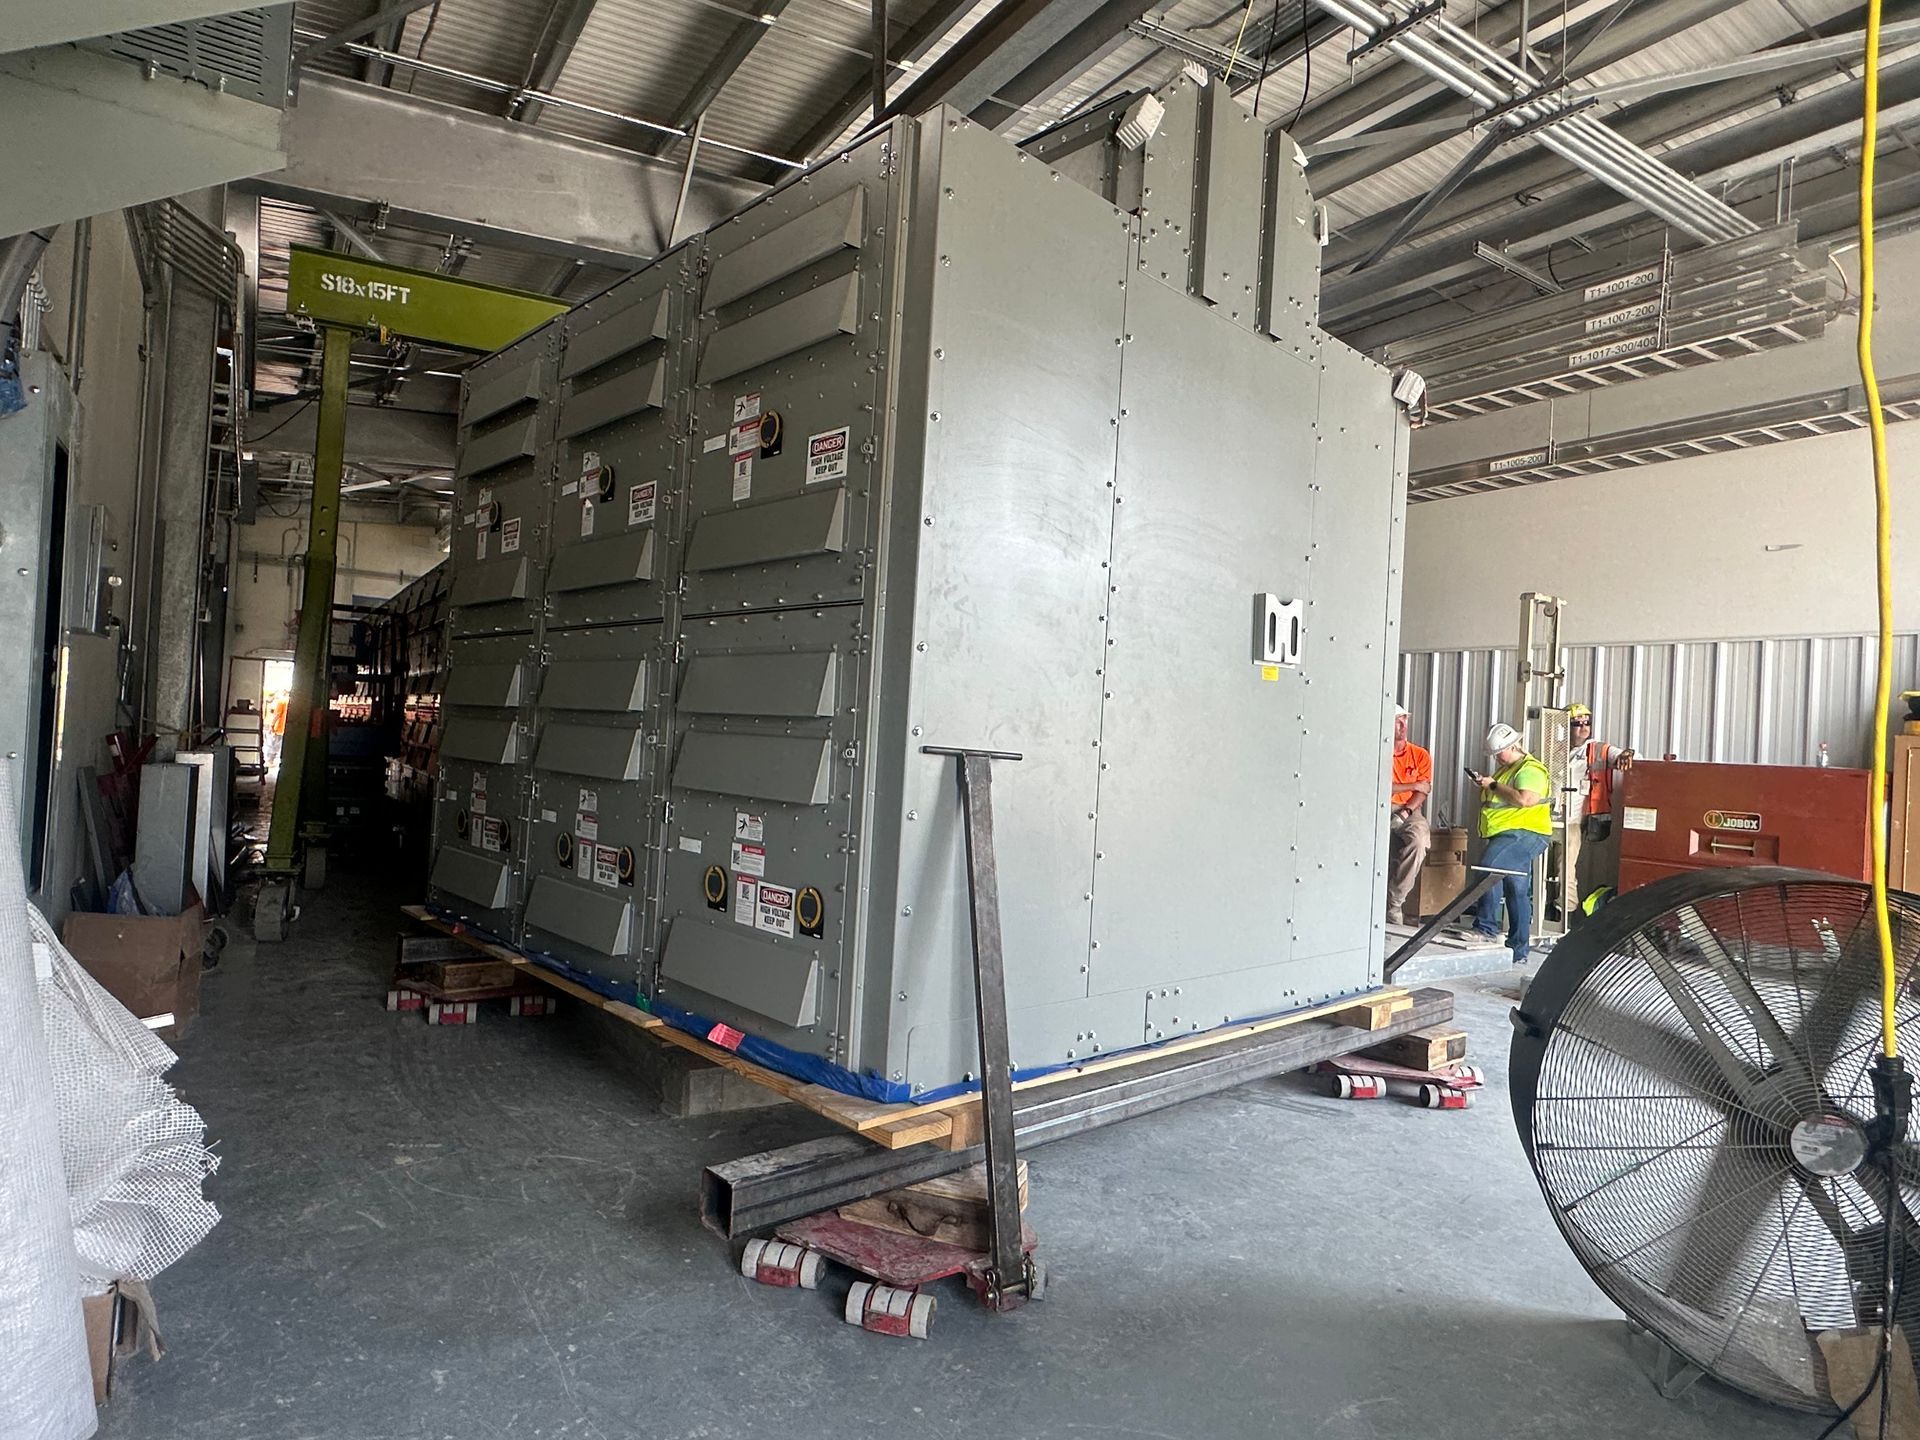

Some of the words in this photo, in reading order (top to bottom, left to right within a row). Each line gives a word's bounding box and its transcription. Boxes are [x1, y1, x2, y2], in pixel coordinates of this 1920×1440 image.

[321, 273, 410, 304] S18x15FT
[1590, 272, 1654, 298] T1-1001-200
[1591, 304, 1655, 330] T1-1007-200
[1571, 336, 1656, 365] T1-1017-300/400
[814, 436, 843, 452] DANGER
[823, 451, 844, 464] VOLTAGE
[815, 465, 827, 475] KEEP
[828, 462, 838, 472] OUT
[1723, 818, 1758, 829] JOBOX
[763, 890, 789, 904] DANGER
[760, 904, 771, 914] HIGH
[771, 907, 791, 920] VOLTAGE
[764, 915, 775, 925] KEEP
[775, 919, 786, 928] OUT
